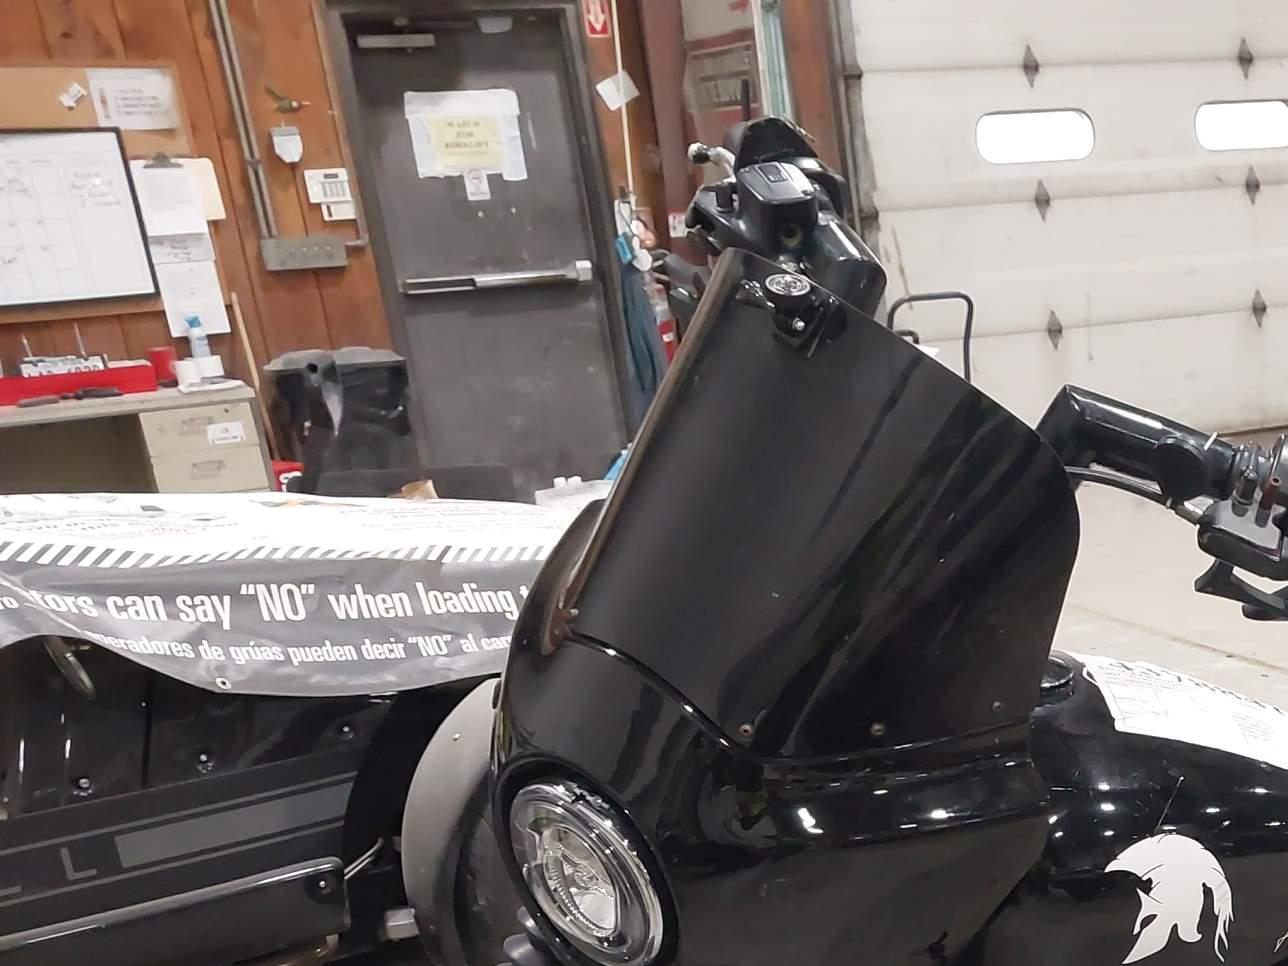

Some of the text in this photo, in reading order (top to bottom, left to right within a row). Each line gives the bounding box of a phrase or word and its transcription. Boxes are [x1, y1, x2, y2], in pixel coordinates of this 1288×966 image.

[106, 595, 168, 622] can
[178, 594, 231, 630] say
[327, 583, 414, 620] when
[415, 582, 520, 621] loading
[199, 640, 225, 661] de
[230, 641, 285, 665] grúas
[287, 640, 358, 666] pueden
[360, 640, 406, 663] decir
[459, 633, 479, 653] al
